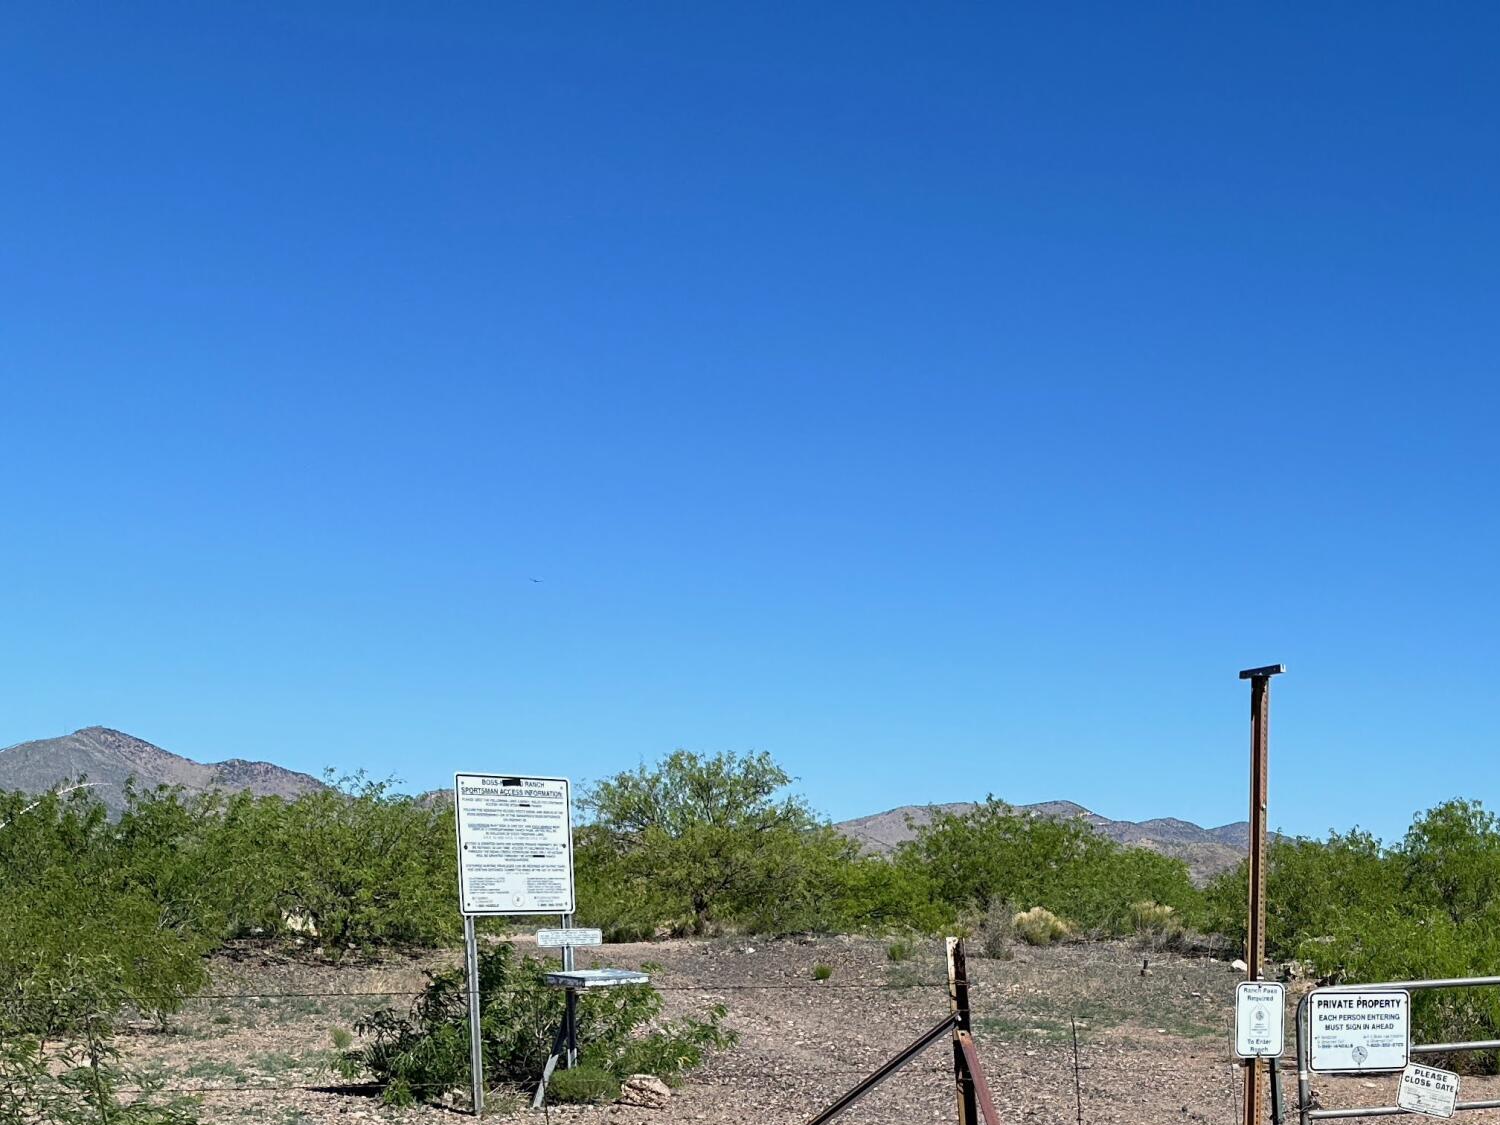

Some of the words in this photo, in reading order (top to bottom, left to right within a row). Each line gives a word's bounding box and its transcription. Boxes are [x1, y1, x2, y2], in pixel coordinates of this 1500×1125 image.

[461, 787, 498, 795] SPORTSMAN
[500, 788, 523, 796] ACCESS
[525, 790, 562, 798] INFORMATION
[1317, 1000, 1353, 1008] PRIVATE
[1356, 999, 1401, 1008] PROPERTY
[1415, 1069, 1448, 1082] PLEASE
[1405, 1076, 1431, 1087] CLOSE
[1436, 1083, 1454, 1092] GATE
